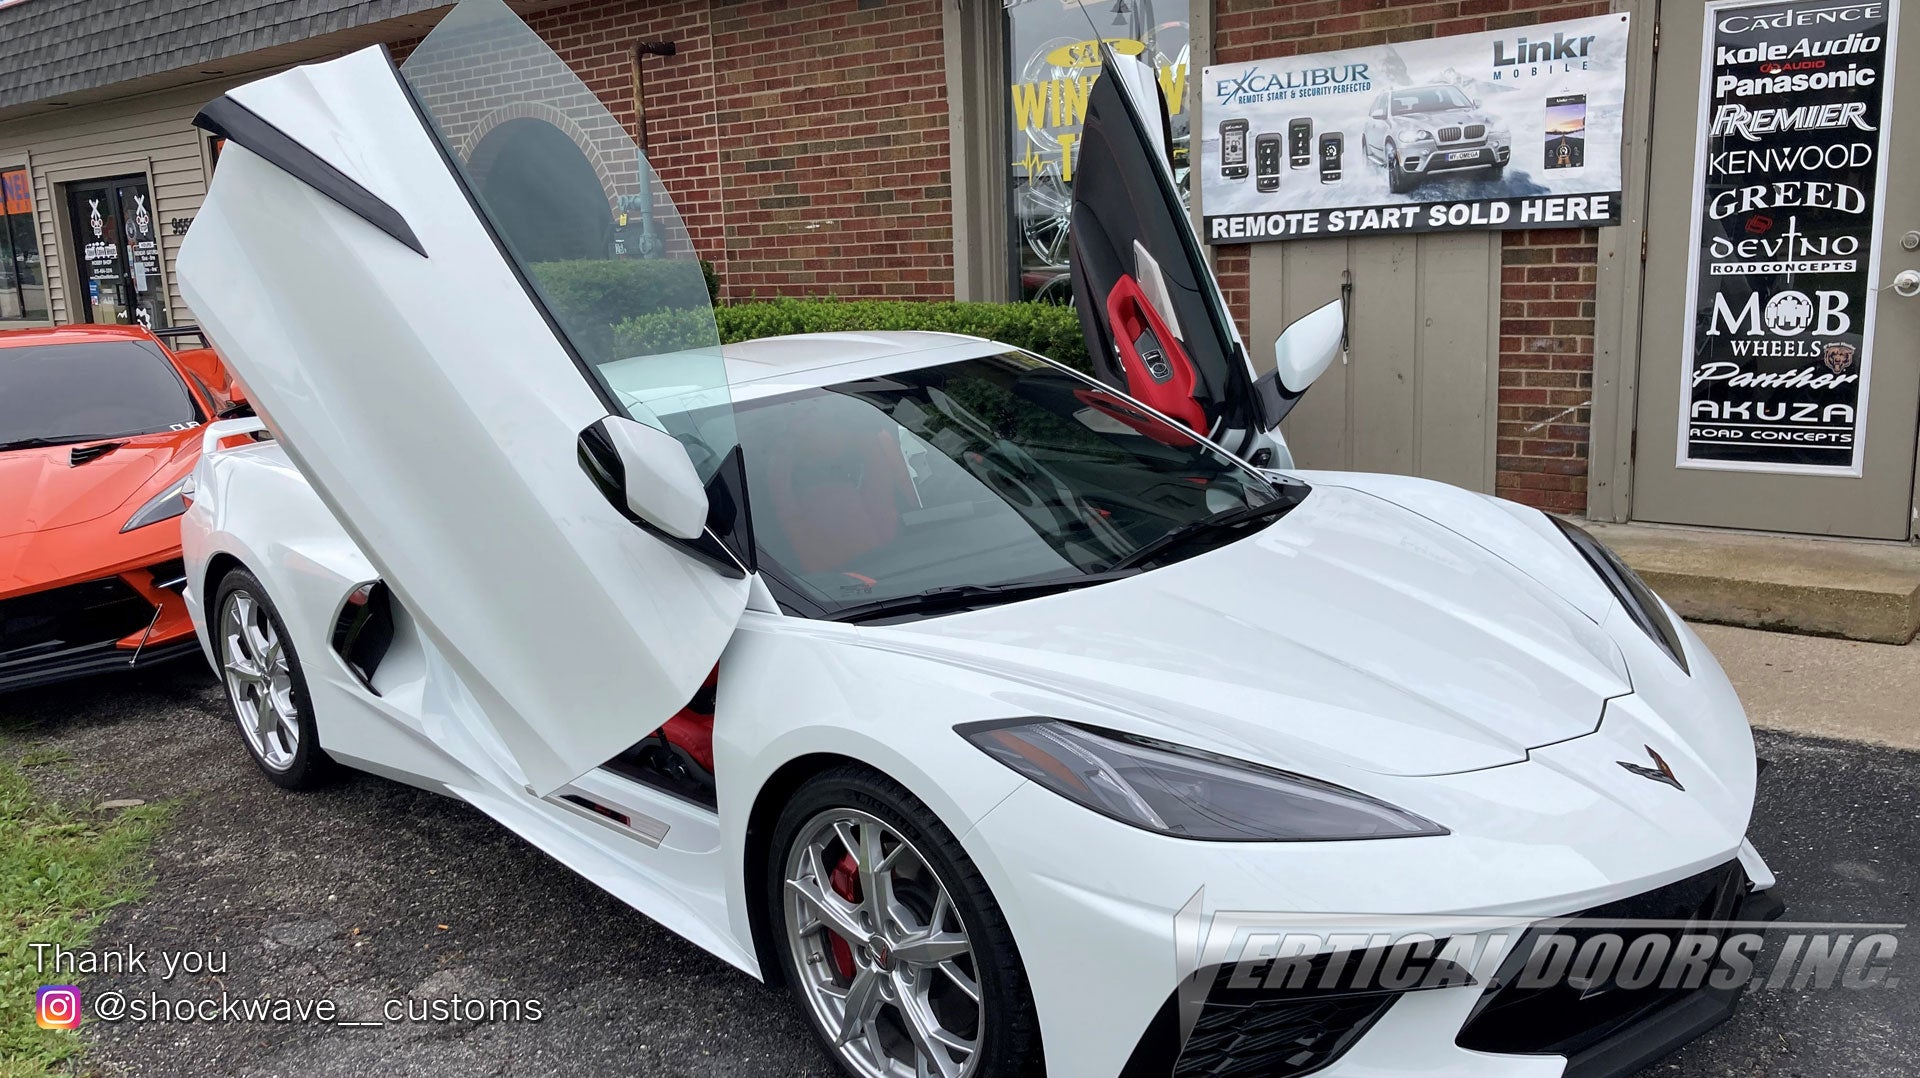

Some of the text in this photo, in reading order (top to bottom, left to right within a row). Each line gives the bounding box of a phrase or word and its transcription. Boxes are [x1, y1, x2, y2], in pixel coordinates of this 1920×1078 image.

[1493, 32, 1596, 67] Linkr
[1783, 60, 1826, 70] AUDIO
[1216, 64, 1370, 103] EXCALIBUR
[1493, 61, 1588, 80] MOBILE
[1715, 63, 1876, 98] Panasonic
[1012, 64, 1187, 131] WINW
[1238, 82, 1371, 104] REMOTE START & SECURITY PERFECTED
[1709, 101, 1878, 141] PREMIER
[1709, 143, 1872, 176] KENWOOD
[1211, 195, 1610, 239] REMOTE START SOLD HERE
[1708, 181, 1866, 220] GREED
[1712, 261, 1853, 274] ROAD CONCEPTS
[1706, 290, 1851, 337] MOB
[1730, 340, 1822, 357] WHEELS
[1692, 361, 1859, 390] Panther
[1691, 400, 1854, 423] AKUZA
[1690, 428, 1852, 443] ROAD CONCEPTS
